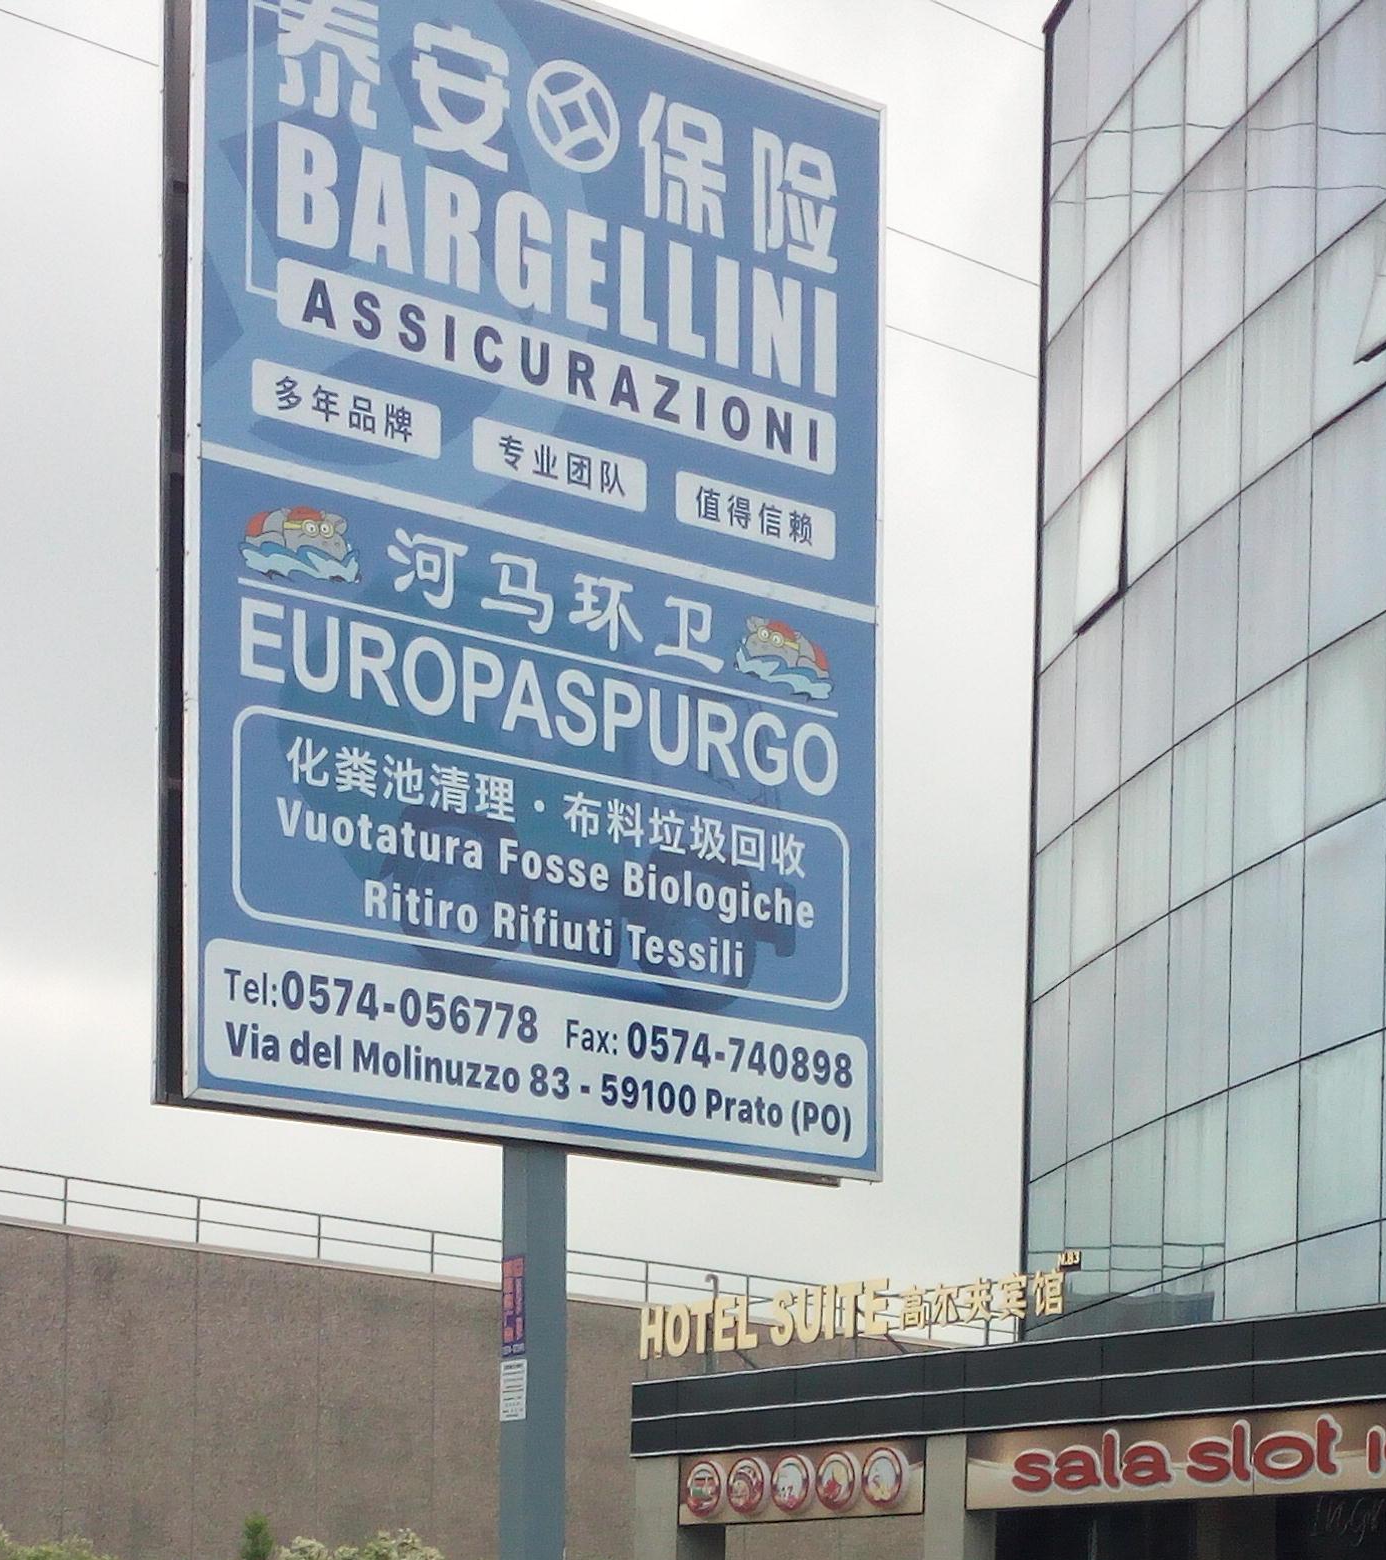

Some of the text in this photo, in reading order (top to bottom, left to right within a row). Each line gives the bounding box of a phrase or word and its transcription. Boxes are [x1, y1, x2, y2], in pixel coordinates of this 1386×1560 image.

[276, 0, 839, 274] 泰安 保险
[276, 121, 838, 398] BARGELLINI
[274, 374, 415, 445] 多年品牌
[302, 277, 819, 462] ASSICURAZIONI
[498, 434, 628, 500] 专业团队
[695, 485, 815, 548] 值得信赖
[386, 527, 727, 675] 河马环卫
[239, 596, 839, 798] EUROPASPURGO
[276, 797, 815, 930] Vuotatura Fosse Biologiche
[287, 735, 516, 824] 化粪池清理
[562, 791, 807, 880] 布料垃圾回收
[364, 879, 746, 980] Ritiro Rifiuti Tessili
[224, 1020, 281, 1063] Via
[289, 1026, 343, 1071] del
[352, 1037, 520, 1096] Molinuzzo
[529, 1061, 570, 1102] 83
[599, 1073, 697, 1120] 59100
[705, 1090, 784, 1131] Prato
[791, 1098, 853, 1143] (PO)
[565, 1016, 619, 1057] Fax:
[626, 1021, 854, 1092] 0574-740898
[639, 1294, 758, 1361] HOTEL
[770, 1277, 891, 1348] SUITE
[1012, 1428, 1174, 1494] sala
[1185, 1414, 1343, 1486] slot
